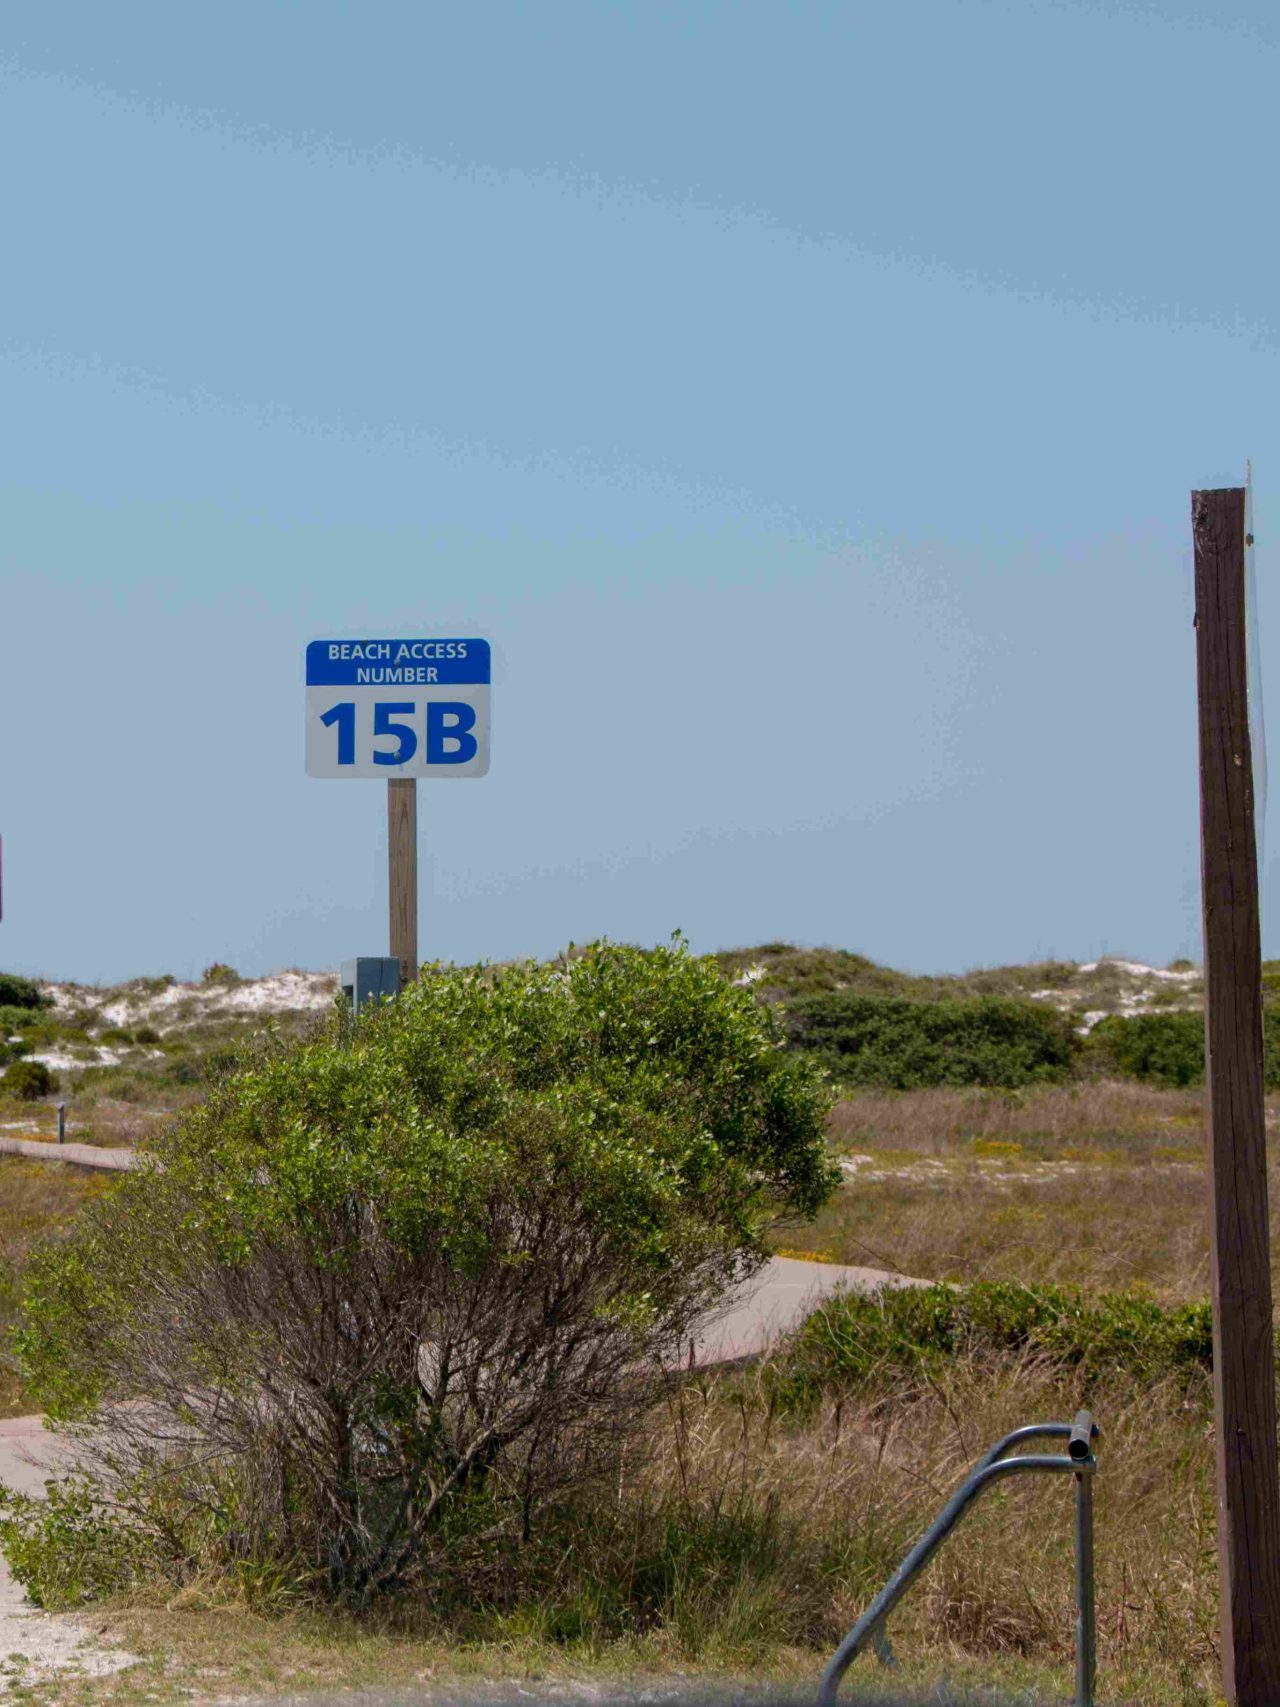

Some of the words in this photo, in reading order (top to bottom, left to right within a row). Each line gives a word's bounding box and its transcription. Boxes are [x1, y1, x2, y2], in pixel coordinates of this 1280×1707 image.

[328, 644, 391, 660] BEACH
[397, 643, 468, 659] ACCESS
[357, 667, 438, 683] NUMBER
[320, 702, 478, 766] 15B
